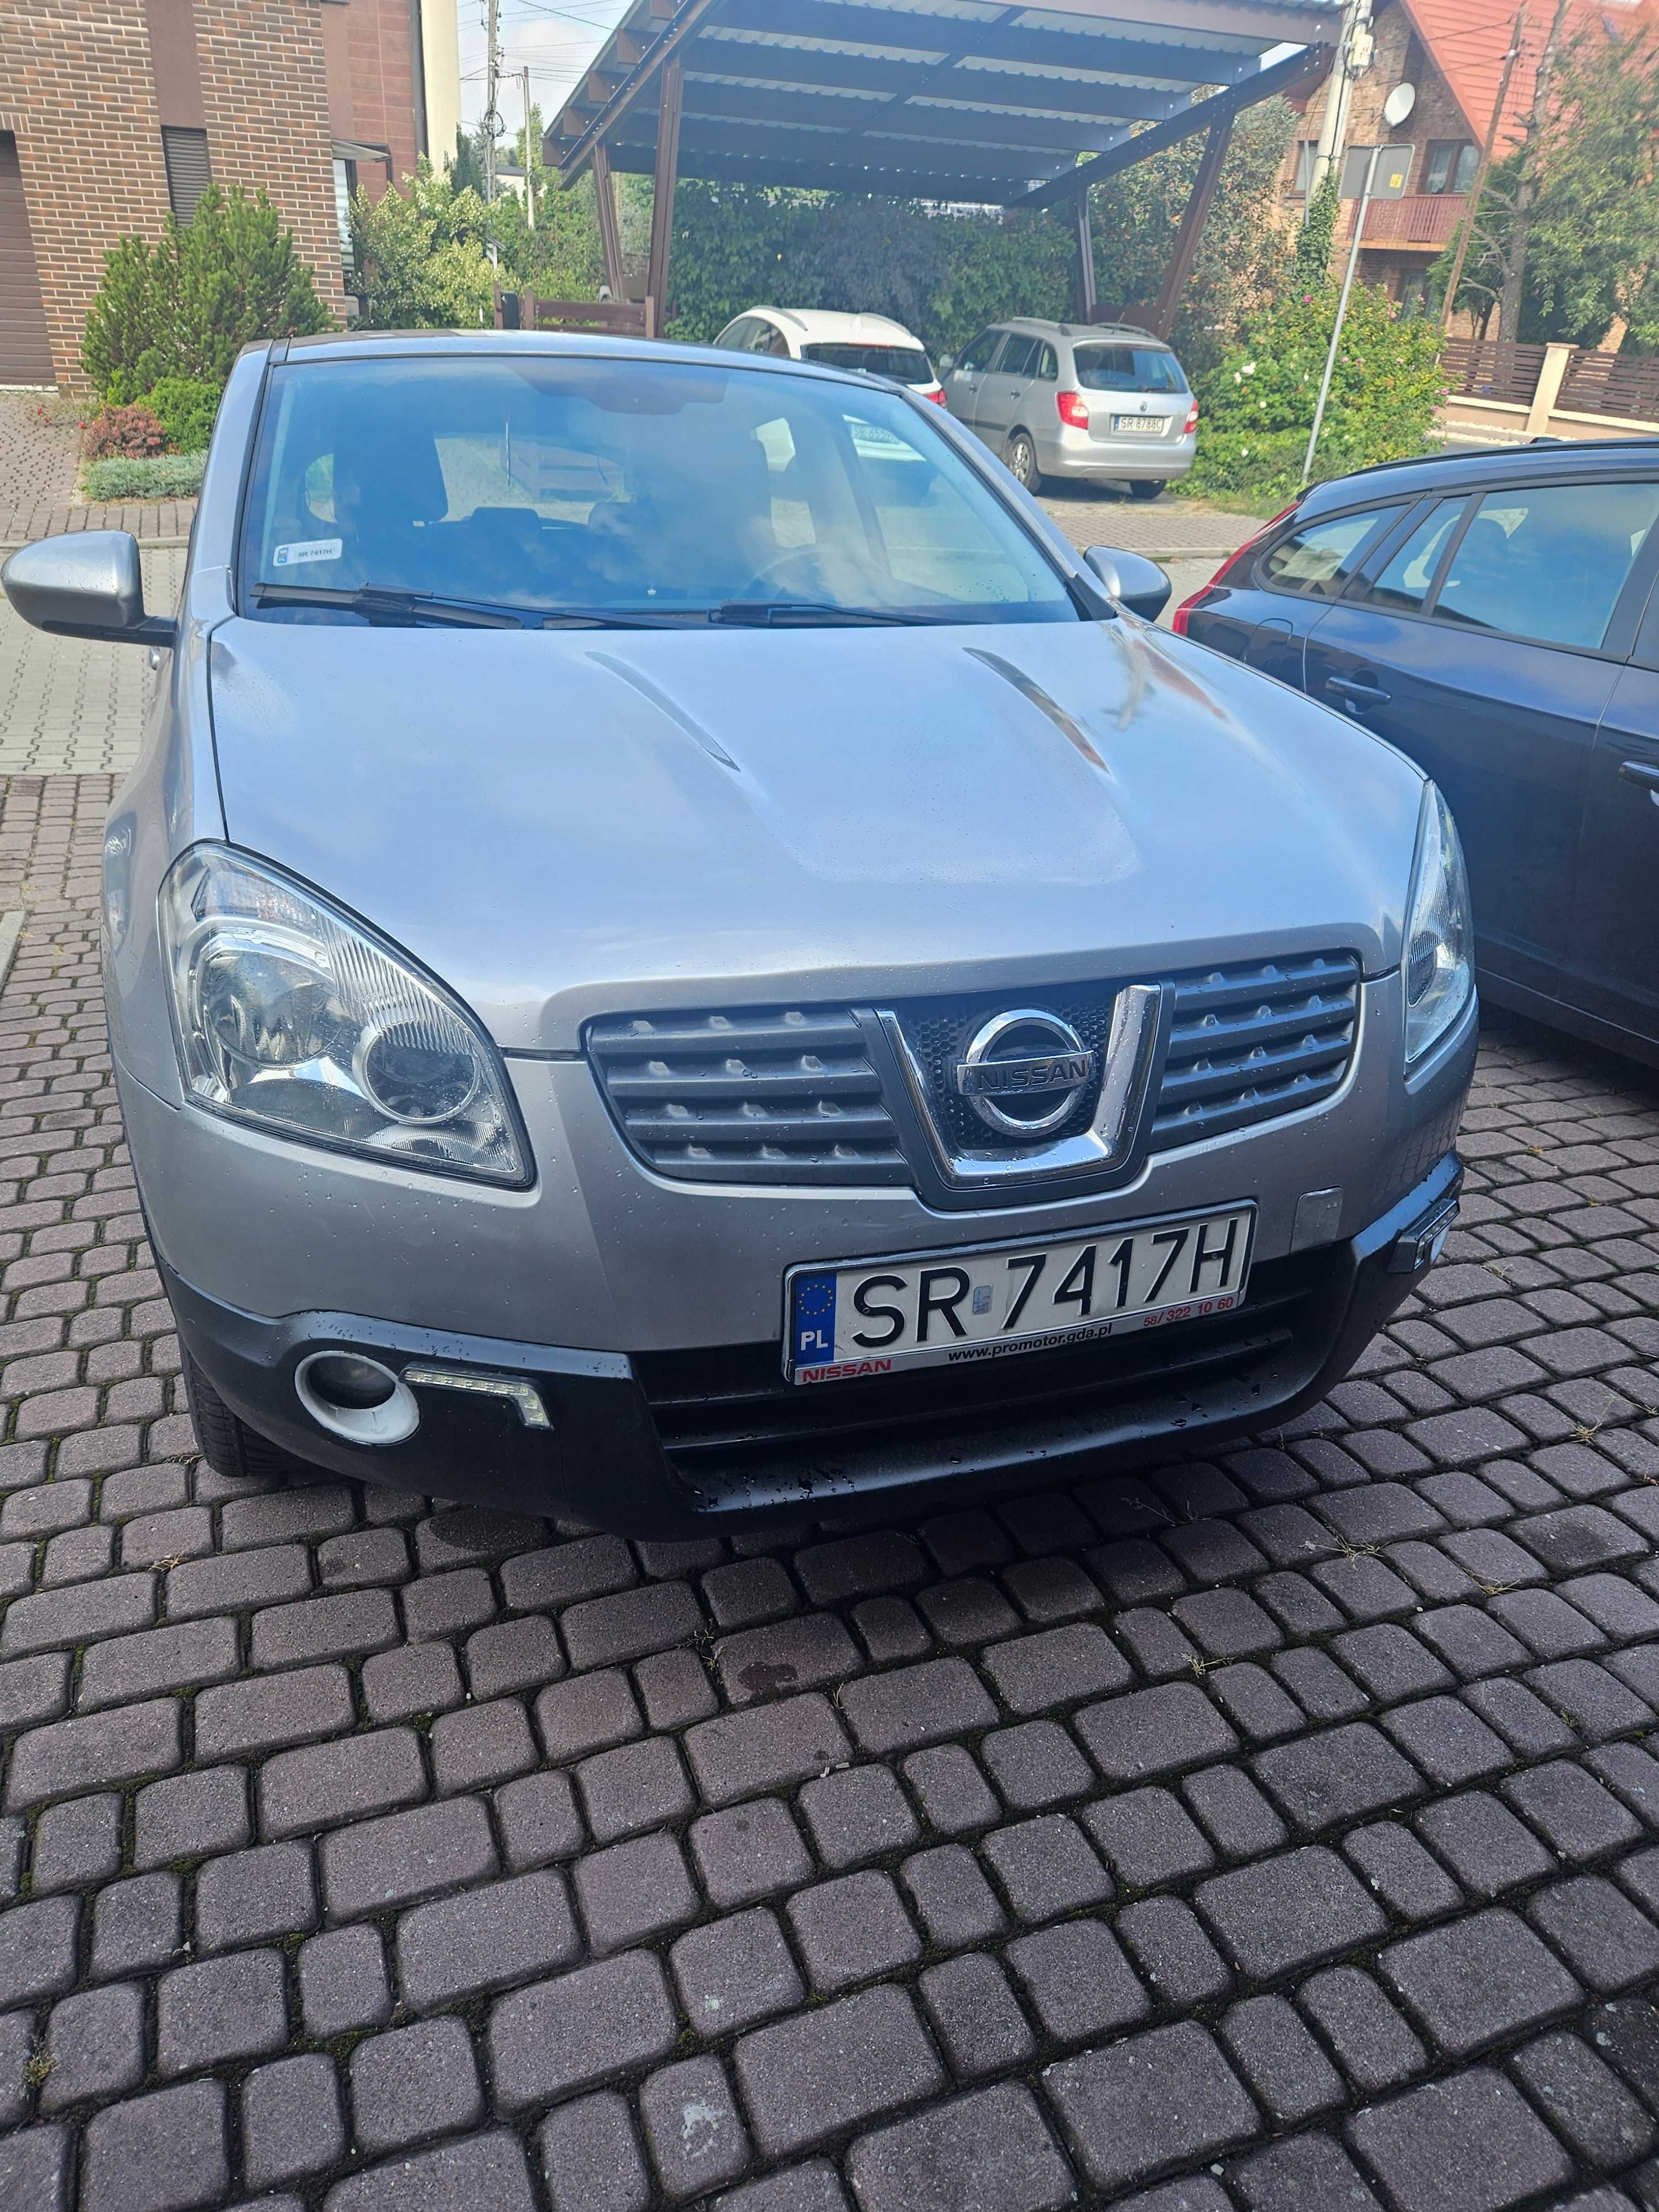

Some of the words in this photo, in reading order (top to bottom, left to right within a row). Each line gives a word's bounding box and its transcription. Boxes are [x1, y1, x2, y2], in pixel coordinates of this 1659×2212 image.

[1121, 418, 1134, 429] SR
[978, 1061, 1087, 1090] NISSAN
[851, 1266, 971, 1348] SR
[1001, 1218, 1238, 1329] 7417H
[1198, 1302, 1213, 1314] 10
[1218, 1297, 1234, 1310] 60
[801, 1330, 828, 1350] PL
[948, 1323, 1113, 1361] www.promotor.gda.pl
[802, 1359, 892, 1382] NISSAN
